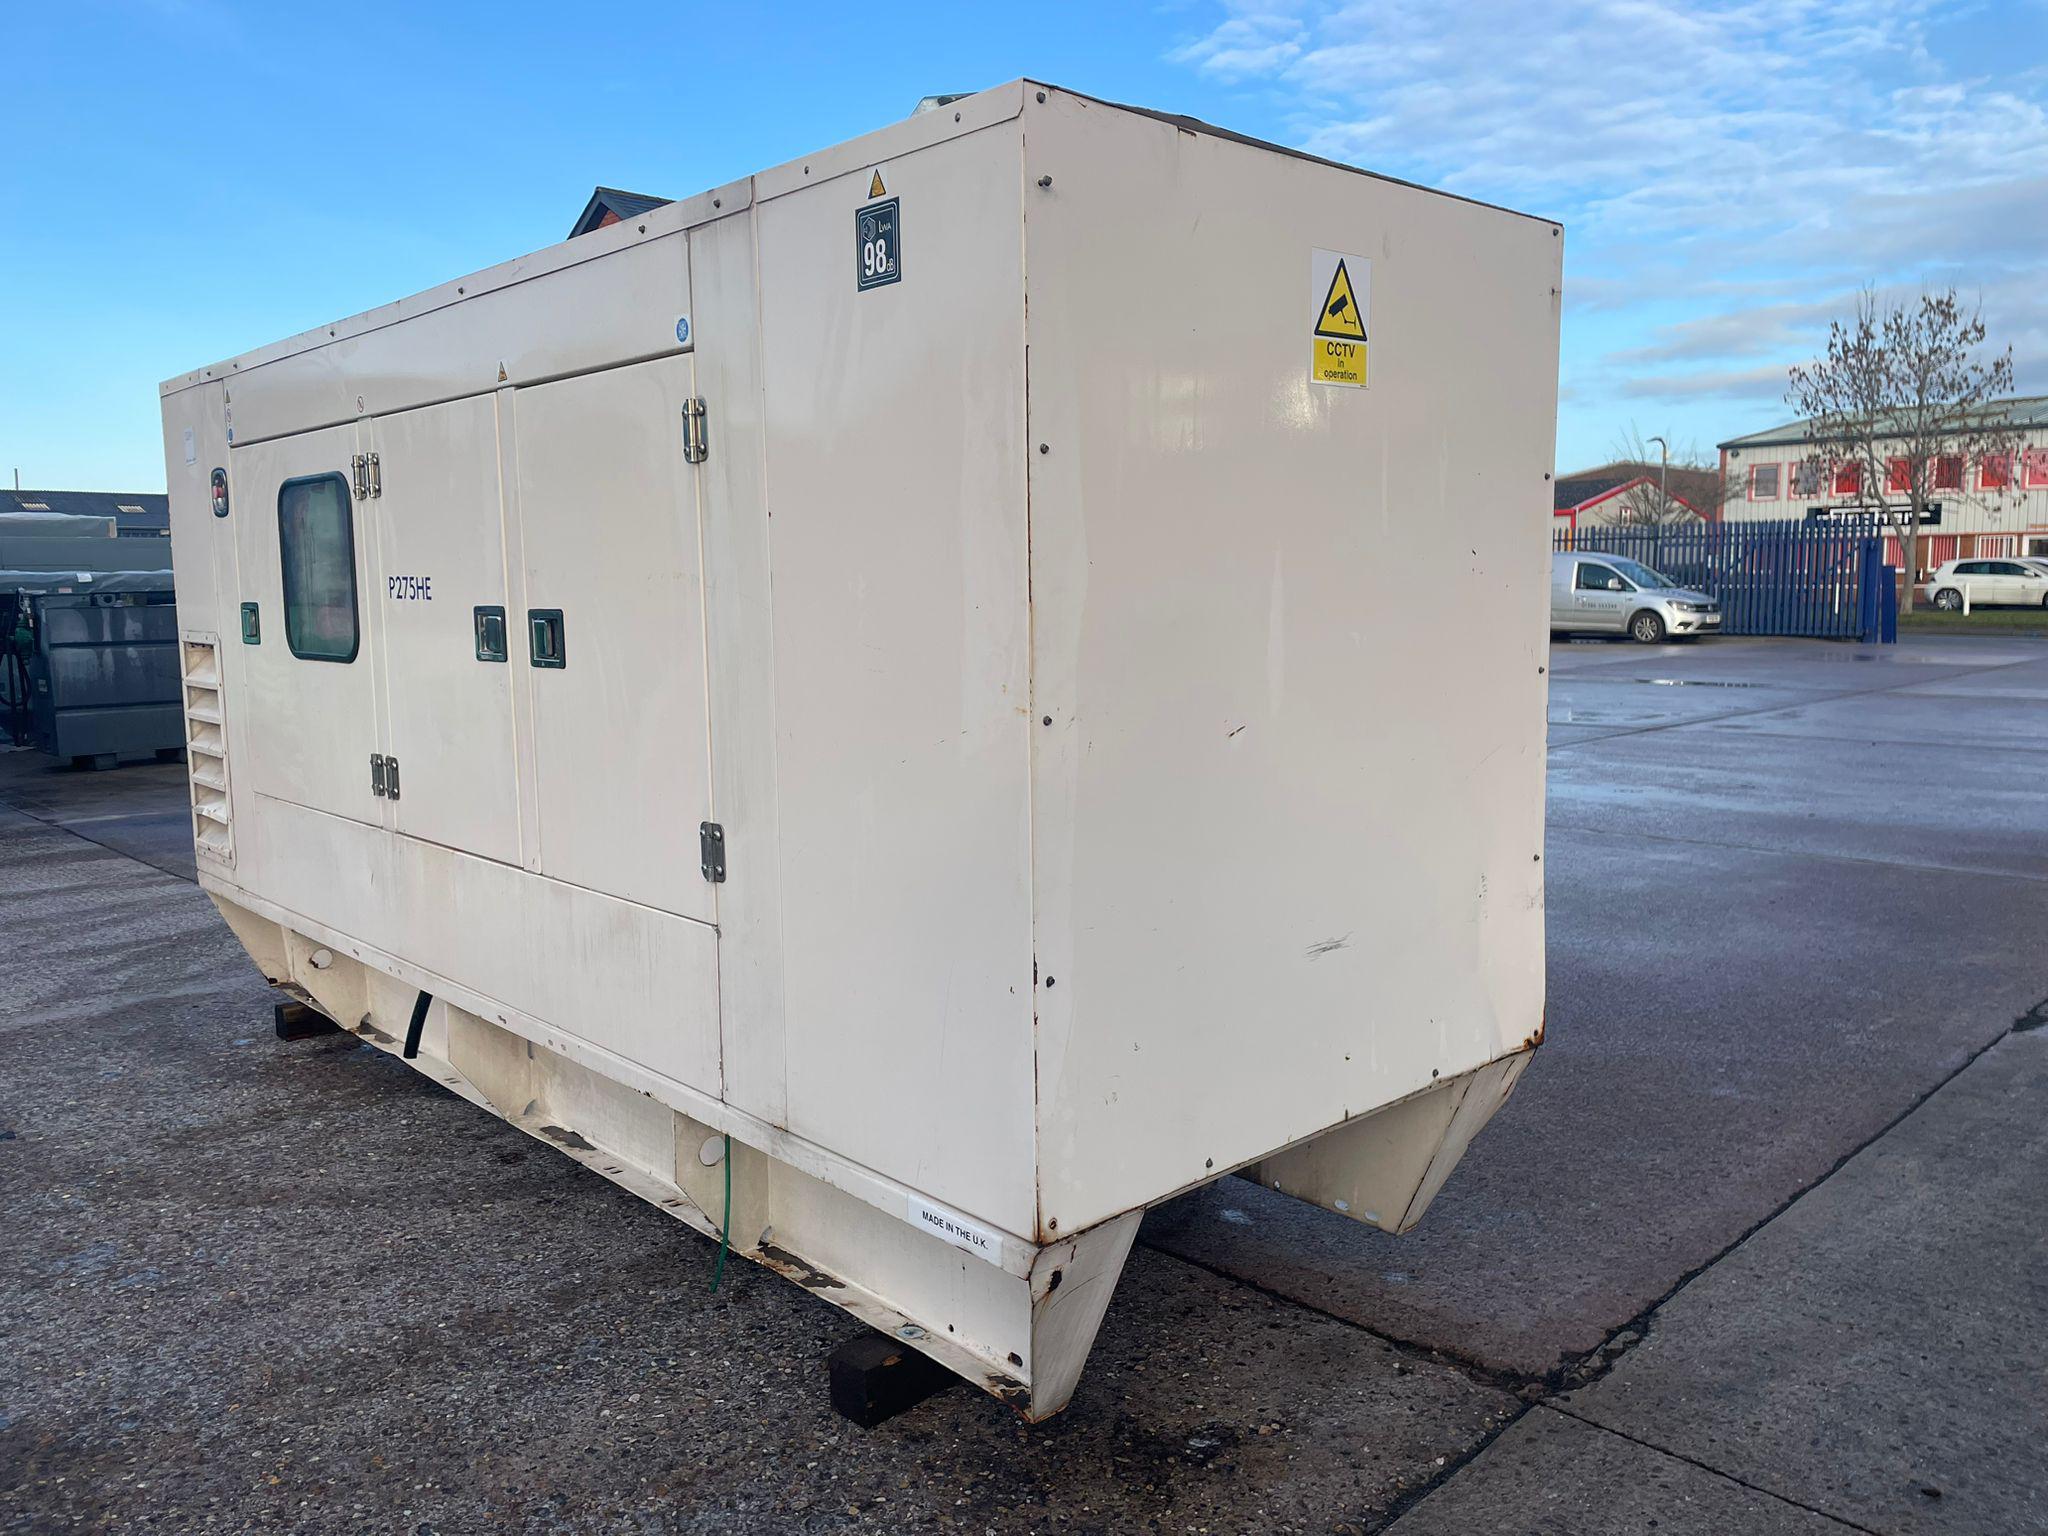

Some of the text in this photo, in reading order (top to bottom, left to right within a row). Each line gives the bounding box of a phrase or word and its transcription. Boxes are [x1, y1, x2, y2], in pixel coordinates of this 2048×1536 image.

[864, 238, 887, 276] 98
[1326, 341, 1356, 358] CCTV
[1323, 369, 1358, 381] operation
[388, 575, 432, 601] P275HE
[922, 1210, 944, 1229] MADE
[945, 1221, 954, 1233] IN
[955, 1226, 971, 1241] THE
